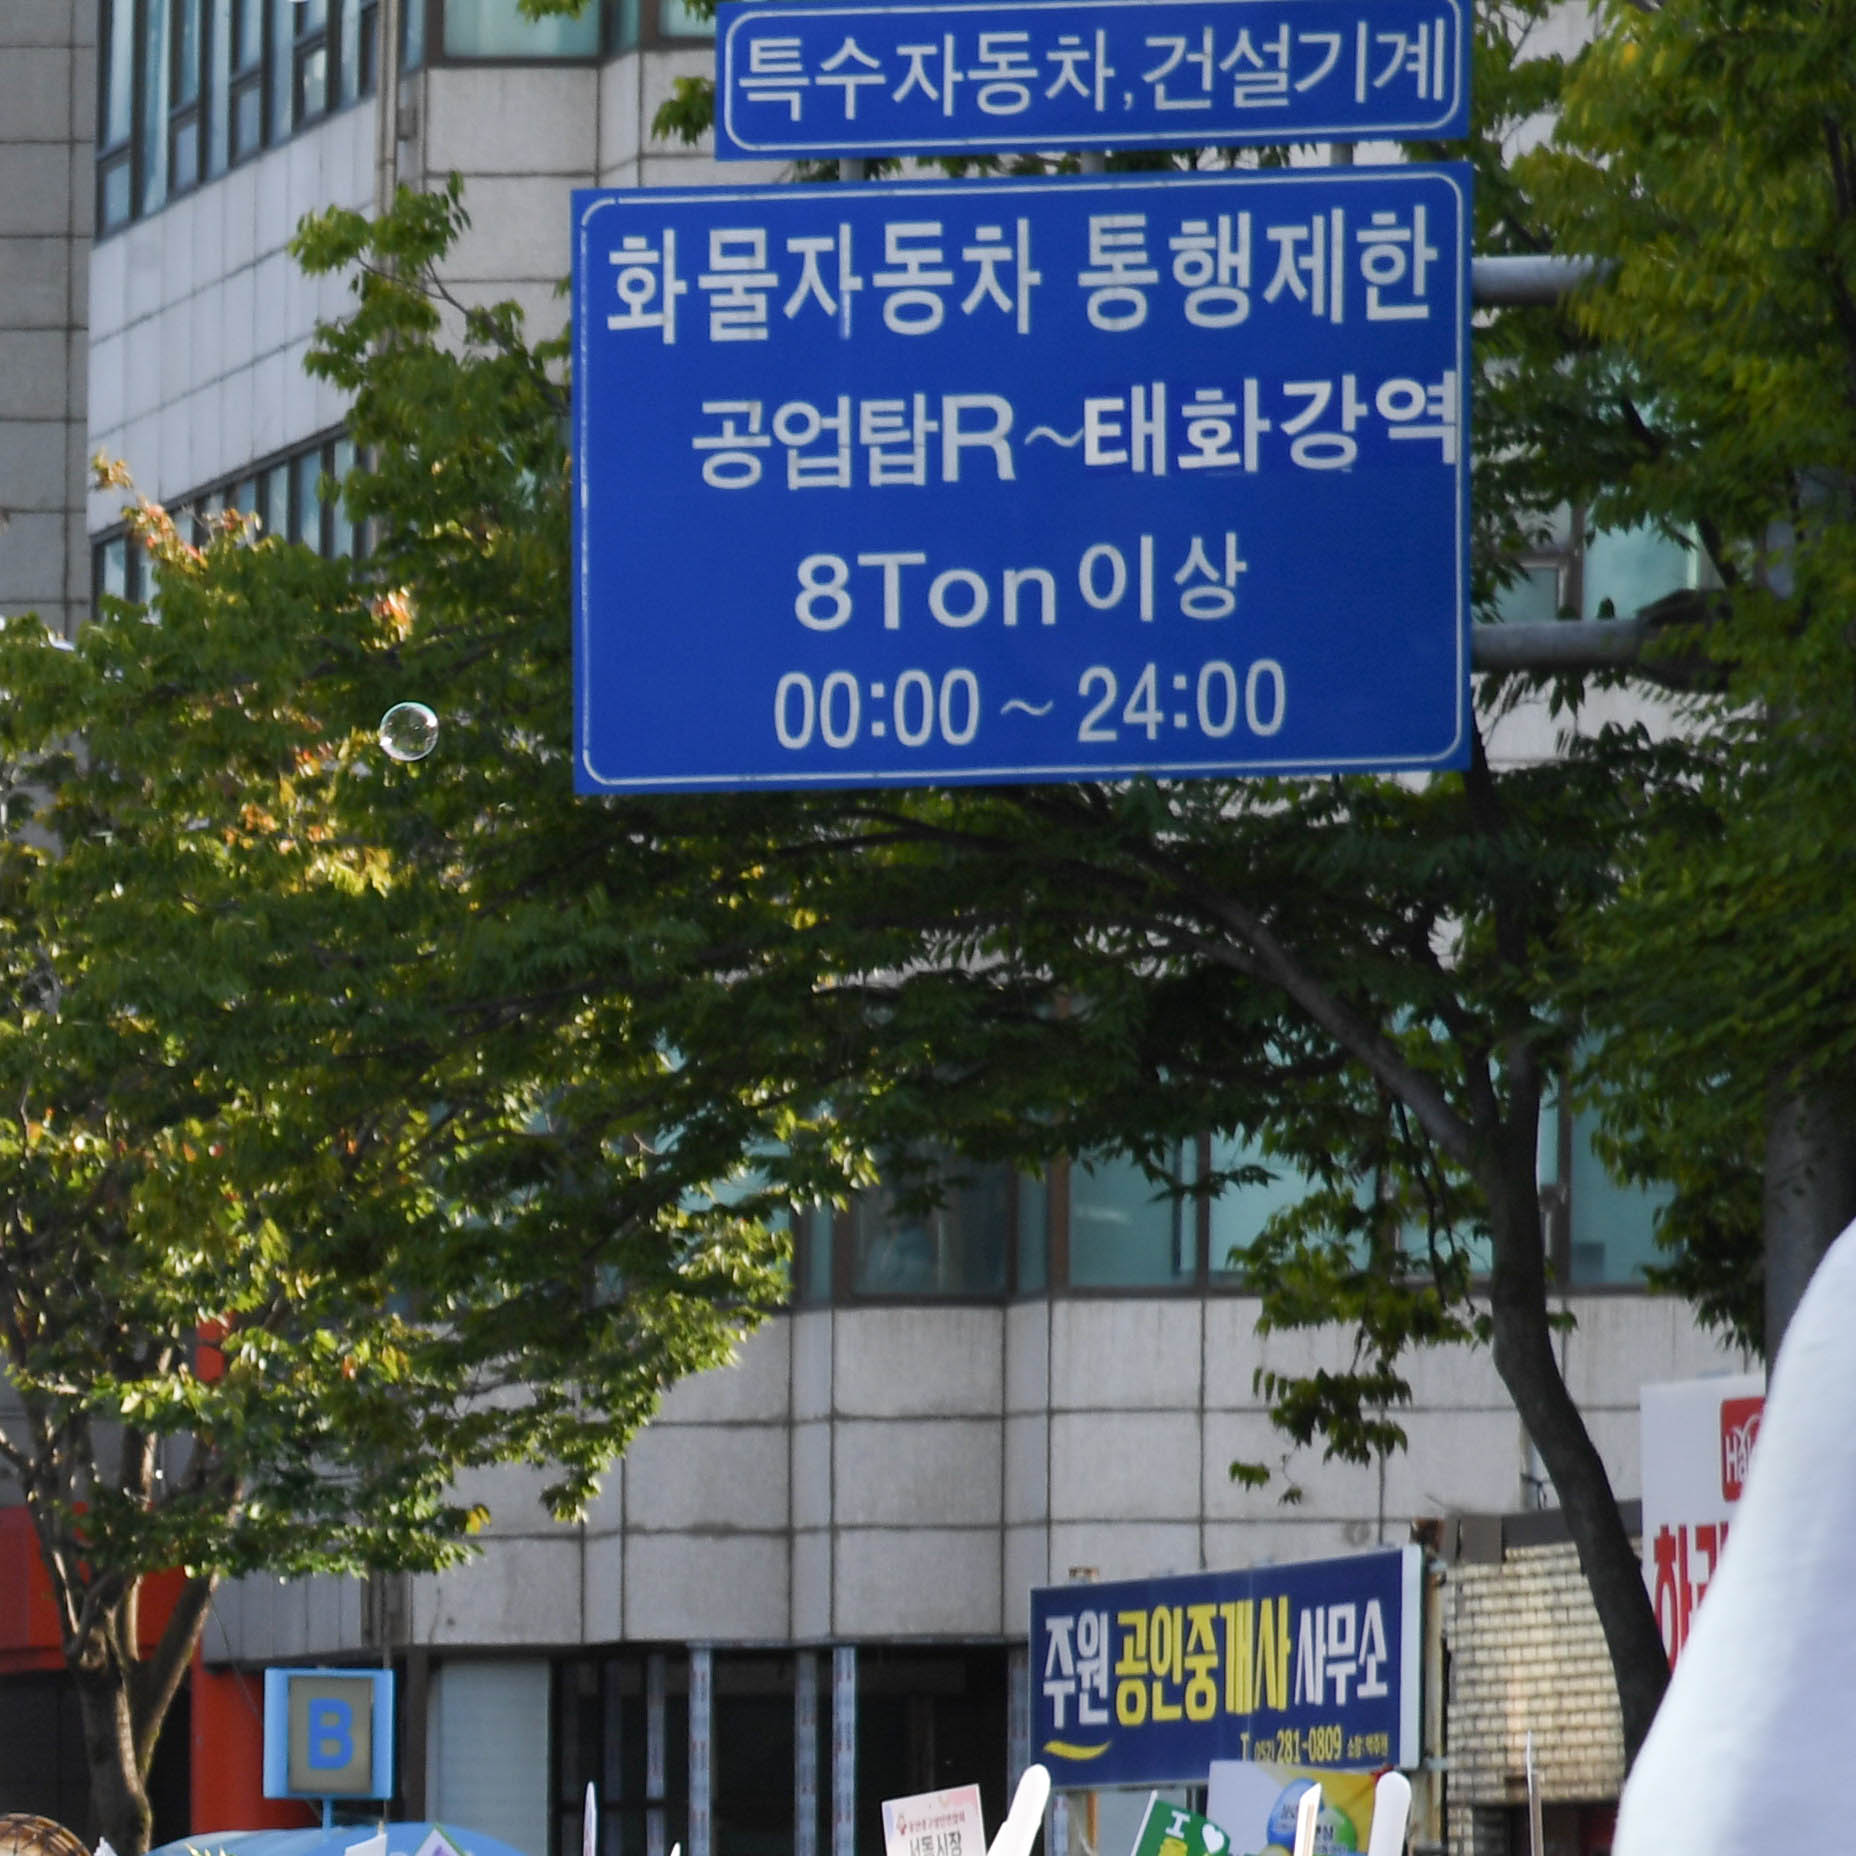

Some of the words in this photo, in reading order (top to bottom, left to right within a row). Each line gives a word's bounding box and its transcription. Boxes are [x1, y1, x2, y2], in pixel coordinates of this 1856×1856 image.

[606, 218, 1041, 345] 화물자동차
[1079, 205, 1437, 332] 통행제한
[775, 668, 980, 749] 00:00
[1079, 660, 1286, 742] 24:00
[1042, 1610, 1110, 1730] 주원
[1114, 1595, 1292, 1727] 공인중개사
[1294, 1598, 1389, 1706] 사무소
[309, 1697, 355, 1771] B
